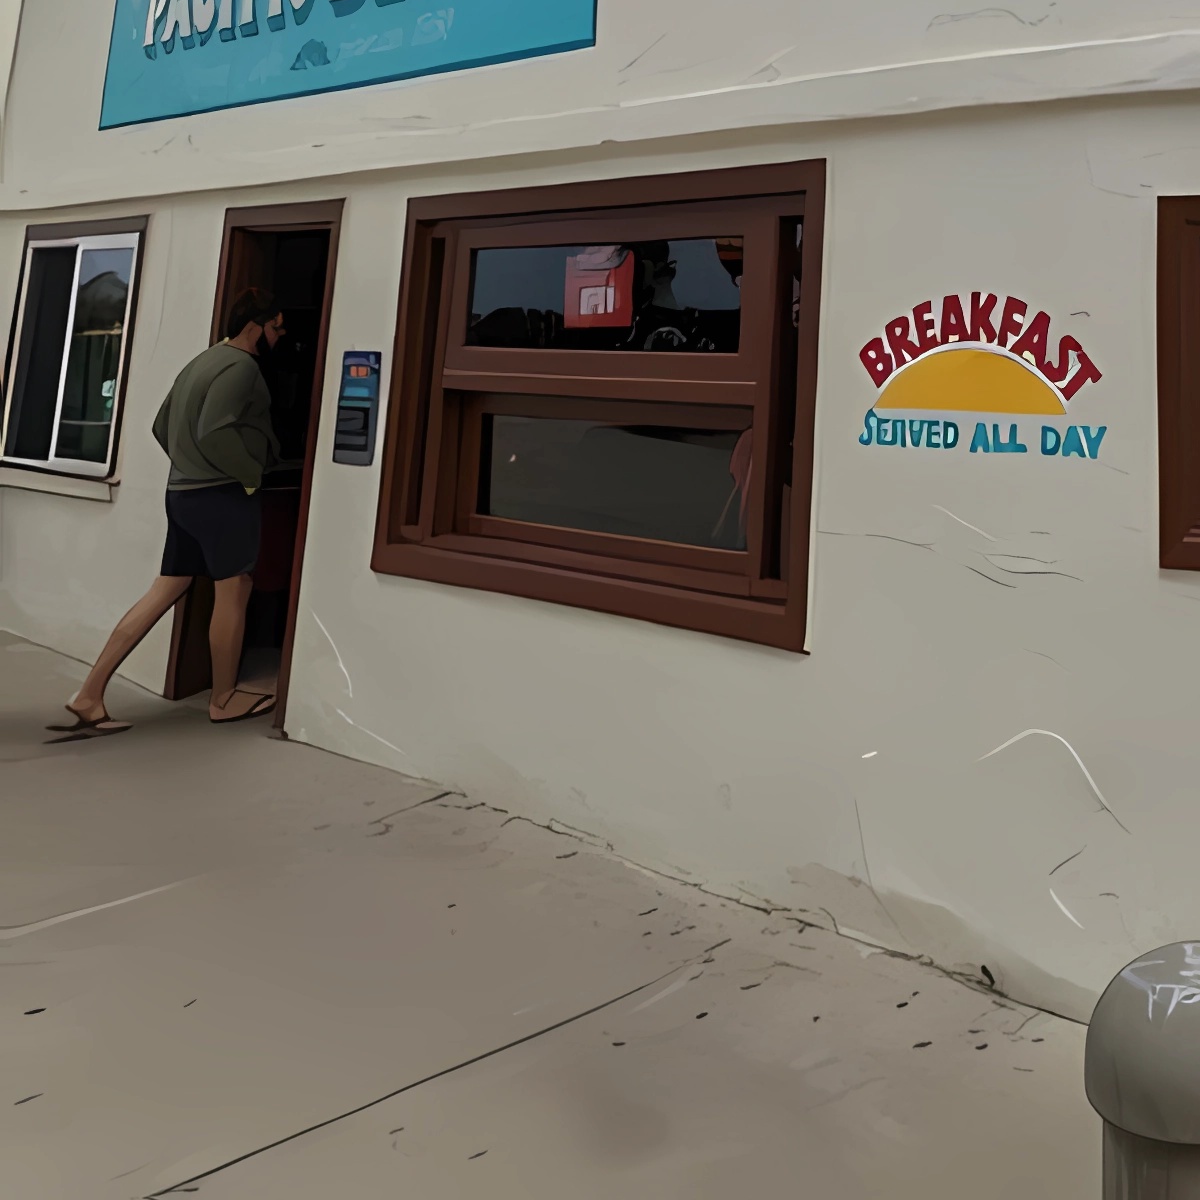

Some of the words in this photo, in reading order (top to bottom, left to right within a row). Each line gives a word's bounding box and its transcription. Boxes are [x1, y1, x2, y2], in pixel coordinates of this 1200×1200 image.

[859, 291, 1102, 401] BREAKFAST
[969, 422, 1028, 453] ALL
[1040, 425, 1107, 459] DAY
